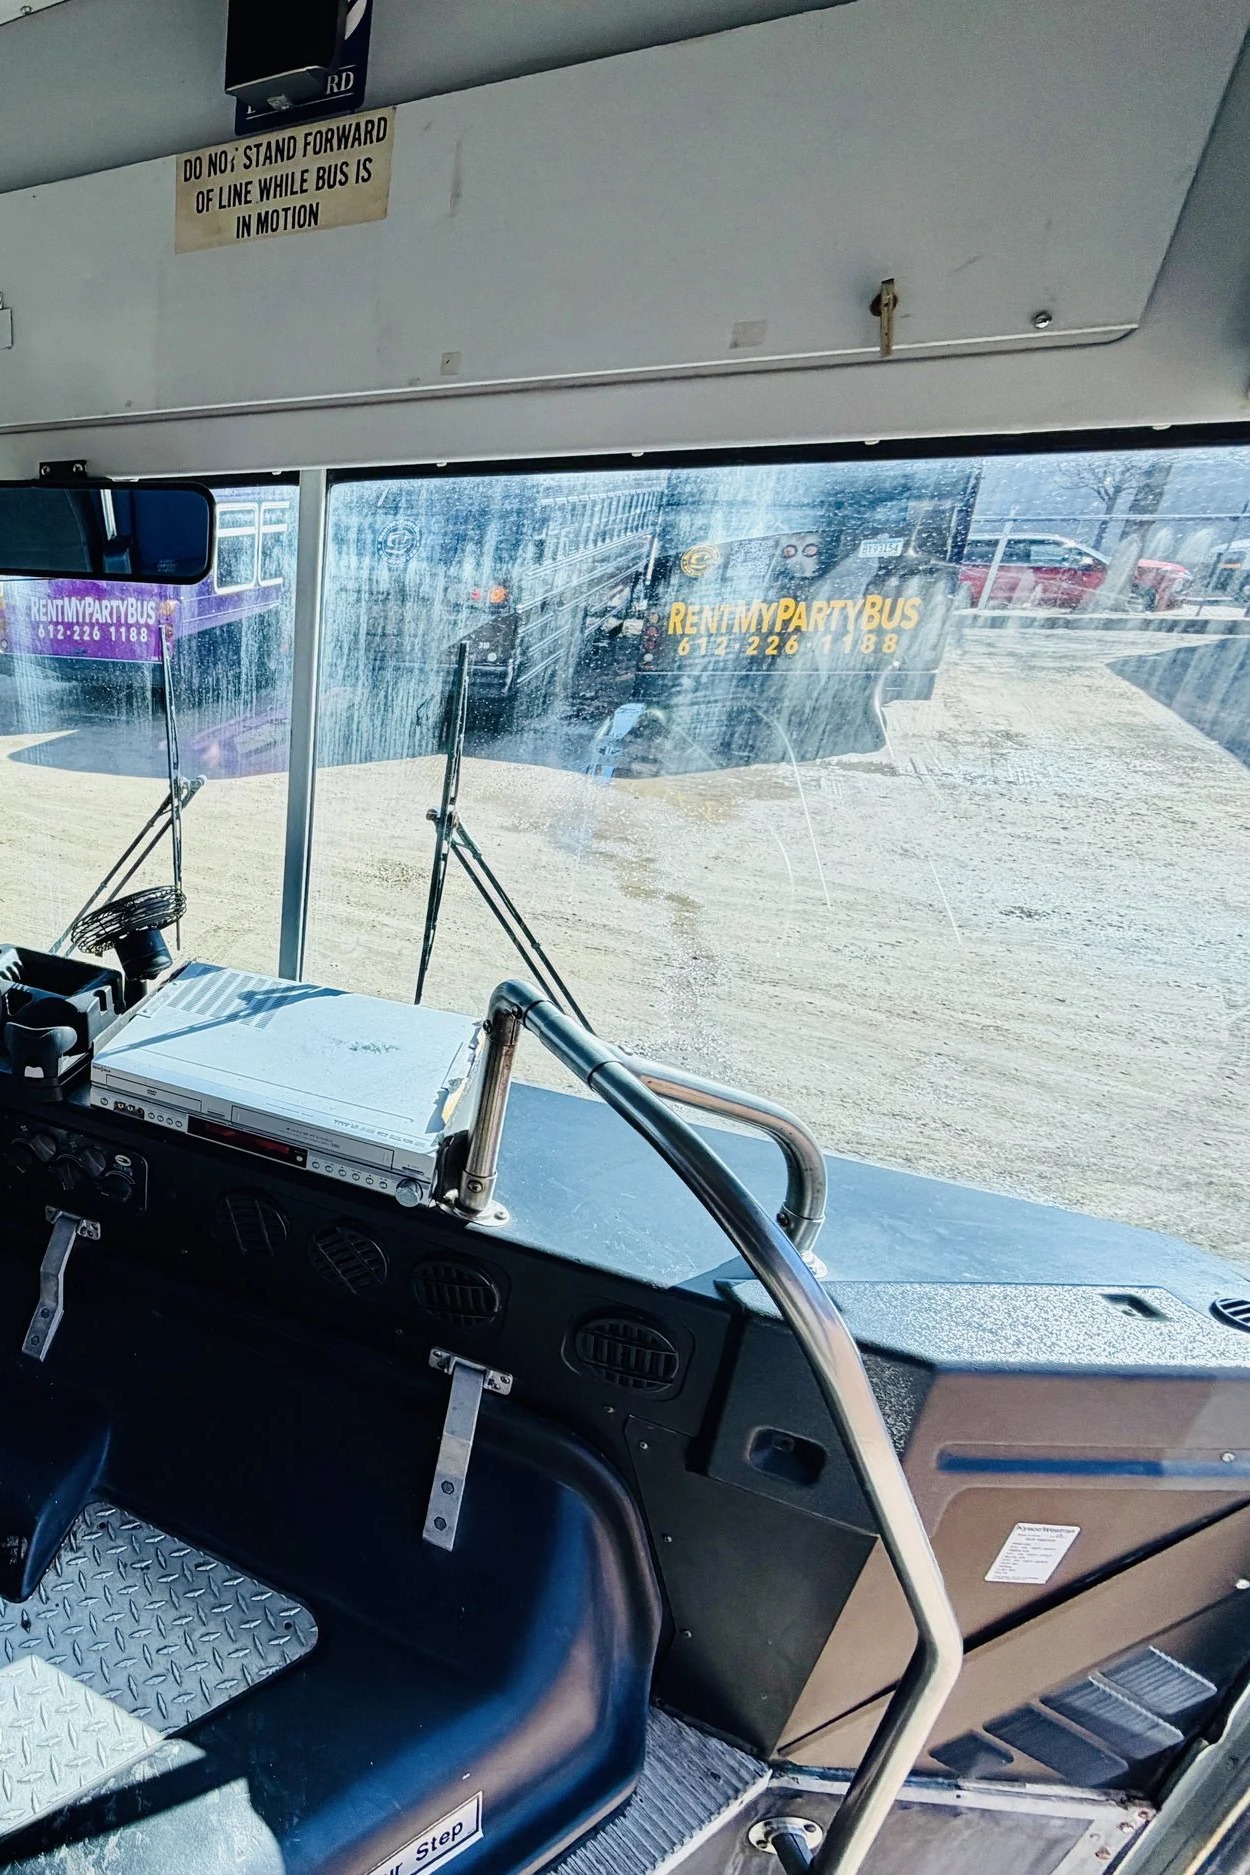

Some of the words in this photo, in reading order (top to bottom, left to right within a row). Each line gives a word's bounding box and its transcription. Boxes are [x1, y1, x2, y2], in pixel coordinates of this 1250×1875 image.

[183, 156, 201, 182] DO
[243, 135, 297, 170] STAND
[302, 117, 388, 158] FORWARD
[195, 189, 214, 214] OF
[218, 180, 253, 210] LINE
[258, 169, 309, 203] WHILE
[315, 161, 350, 191] BUS
[355, 157, 373, 185] IS
[236, 214, 252, 239] IN
[255, 202, 320, 236] MOTION
[30, 596, 157, 625] RENTMYPARTYBUS
[667, 594, 922, 635] RENTMYPARTYBUS
[415, 1821, 464, 1862] Step
